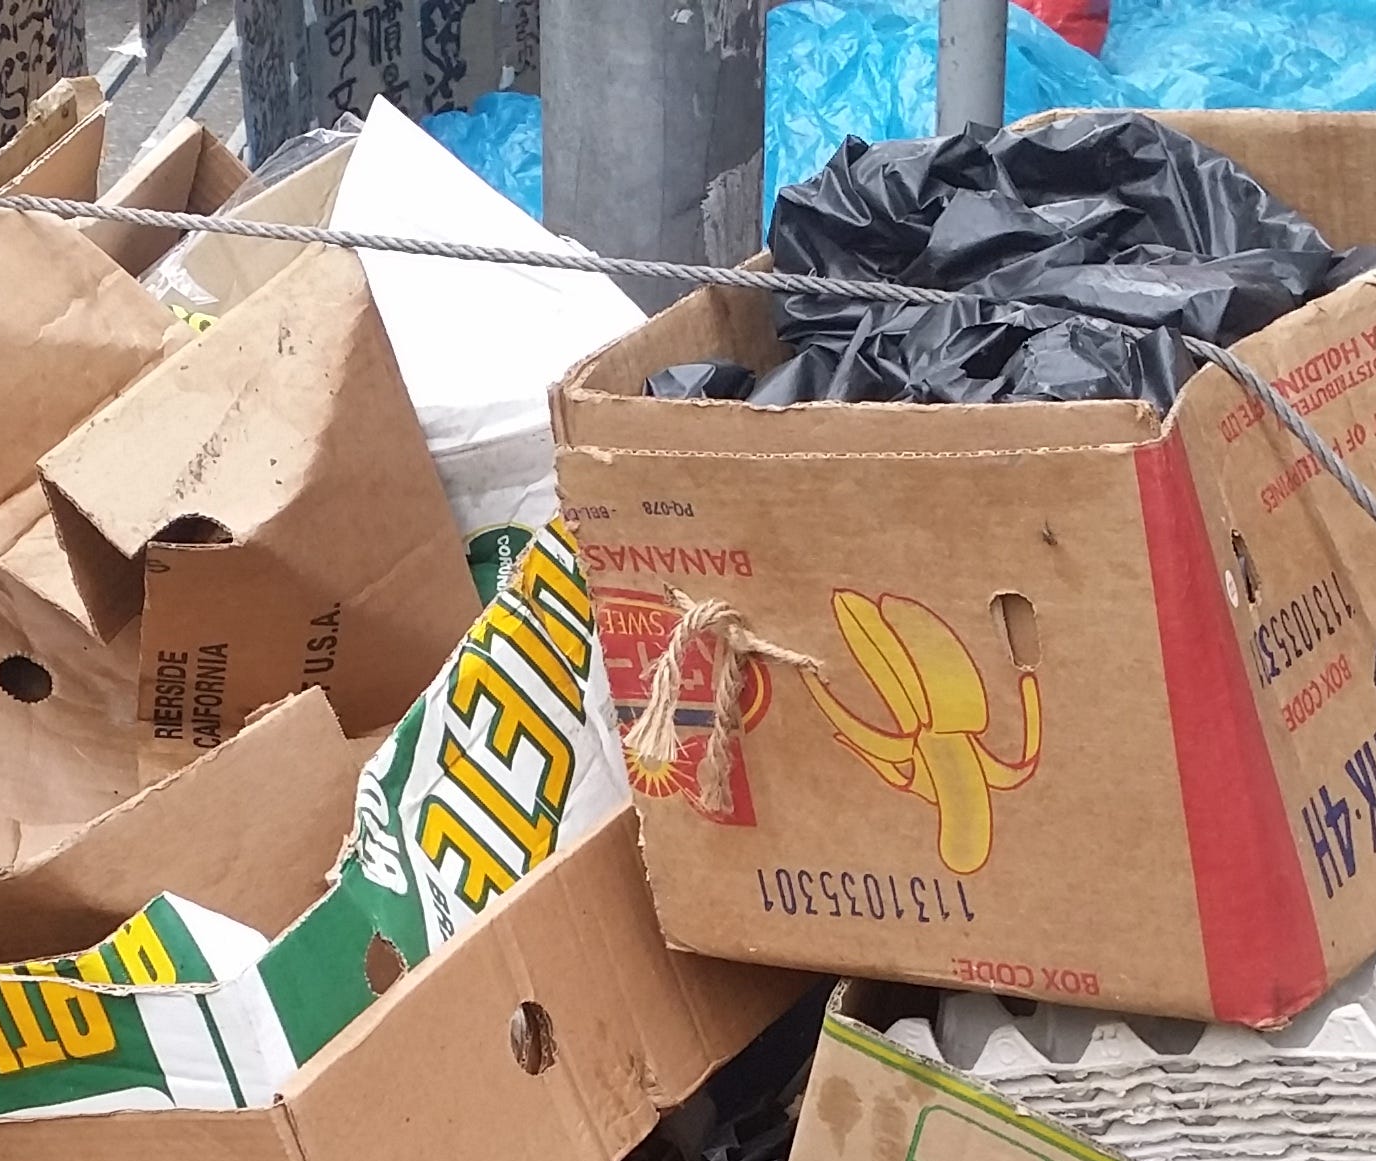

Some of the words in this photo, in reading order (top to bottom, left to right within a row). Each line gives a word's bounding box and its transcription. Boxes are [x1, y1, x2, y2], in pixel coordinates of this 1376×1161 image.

[1346, 421, 1368, 452] OF
[1262, 437, 1346, 515] PILIPPINES
[642, 500, 695, 518] PQ-078
[585, 544, 754, 577] BANANAS
[303, 601, 341, 674] U.S.A.
[1319, 655, 1352, 693] BOX
[1282, 681, 1322, 733] CODE
[757, 866, 975, 922] 1131035301
[952, 957, 1035, 990] CODE:
[1043, 963, 1101, 994] BOX
